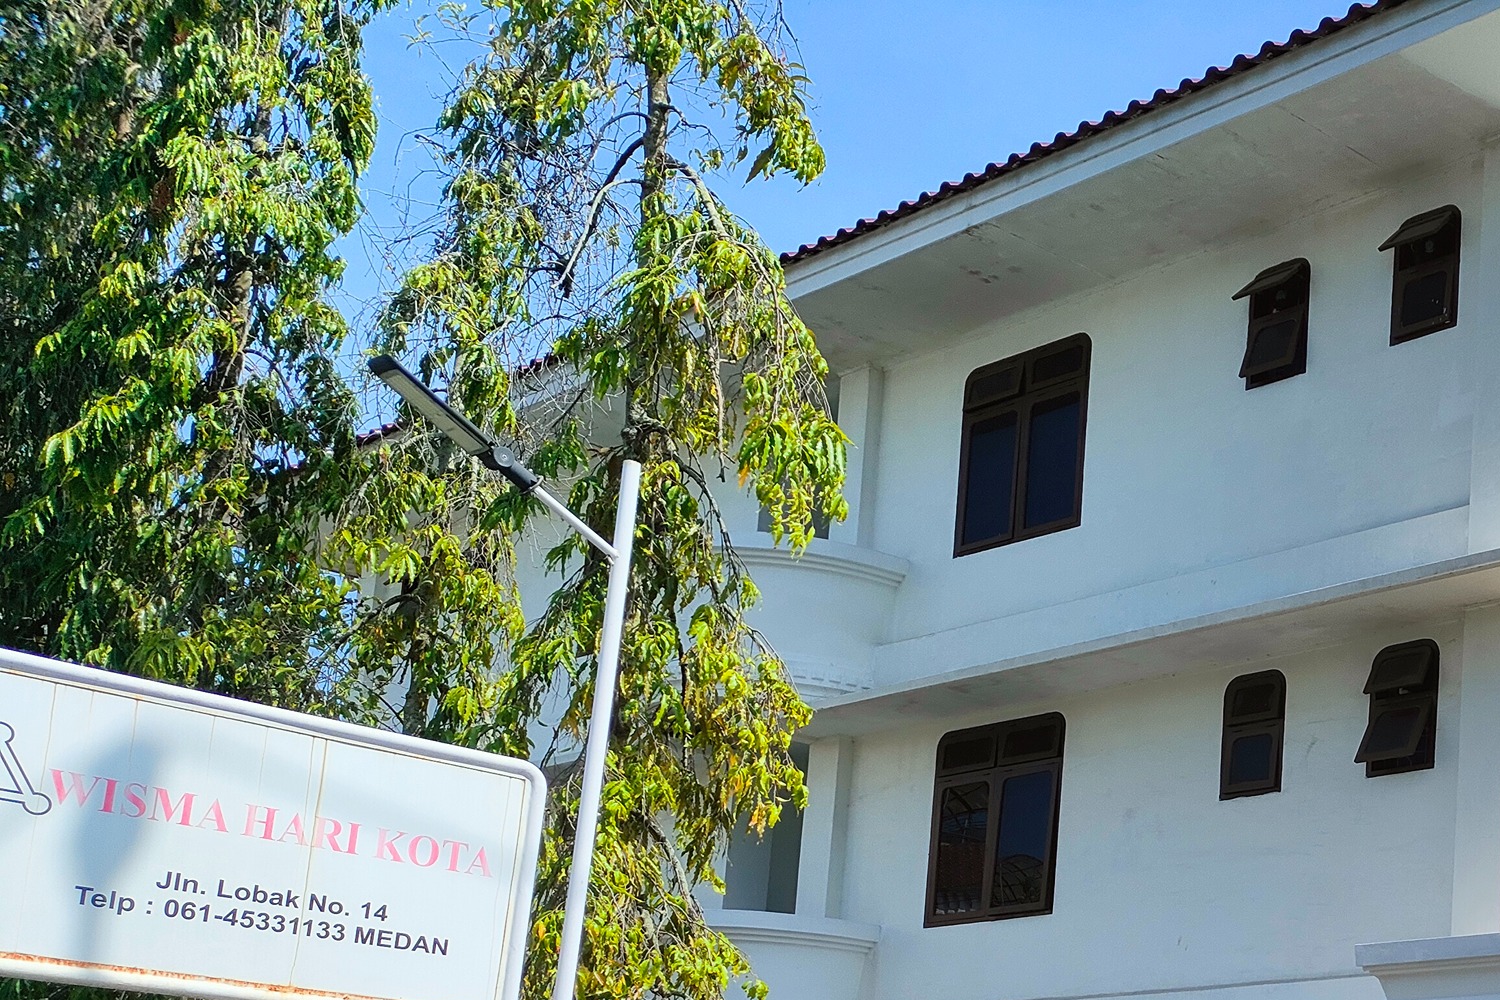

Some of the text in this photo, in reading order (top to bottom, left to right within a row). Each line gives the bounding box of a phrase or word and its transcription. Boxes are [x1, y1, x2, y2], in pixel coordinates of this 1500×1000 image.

[49, 769, 493, 878] WISMA HARI KOTA
[75, 885, 135, 915] Telp
[164, 899, 346, 942] 061-45331133
[354, 926, 449, 956] MEDAN
[156, 871, 387, 922] Jln. Lobak No. 14
